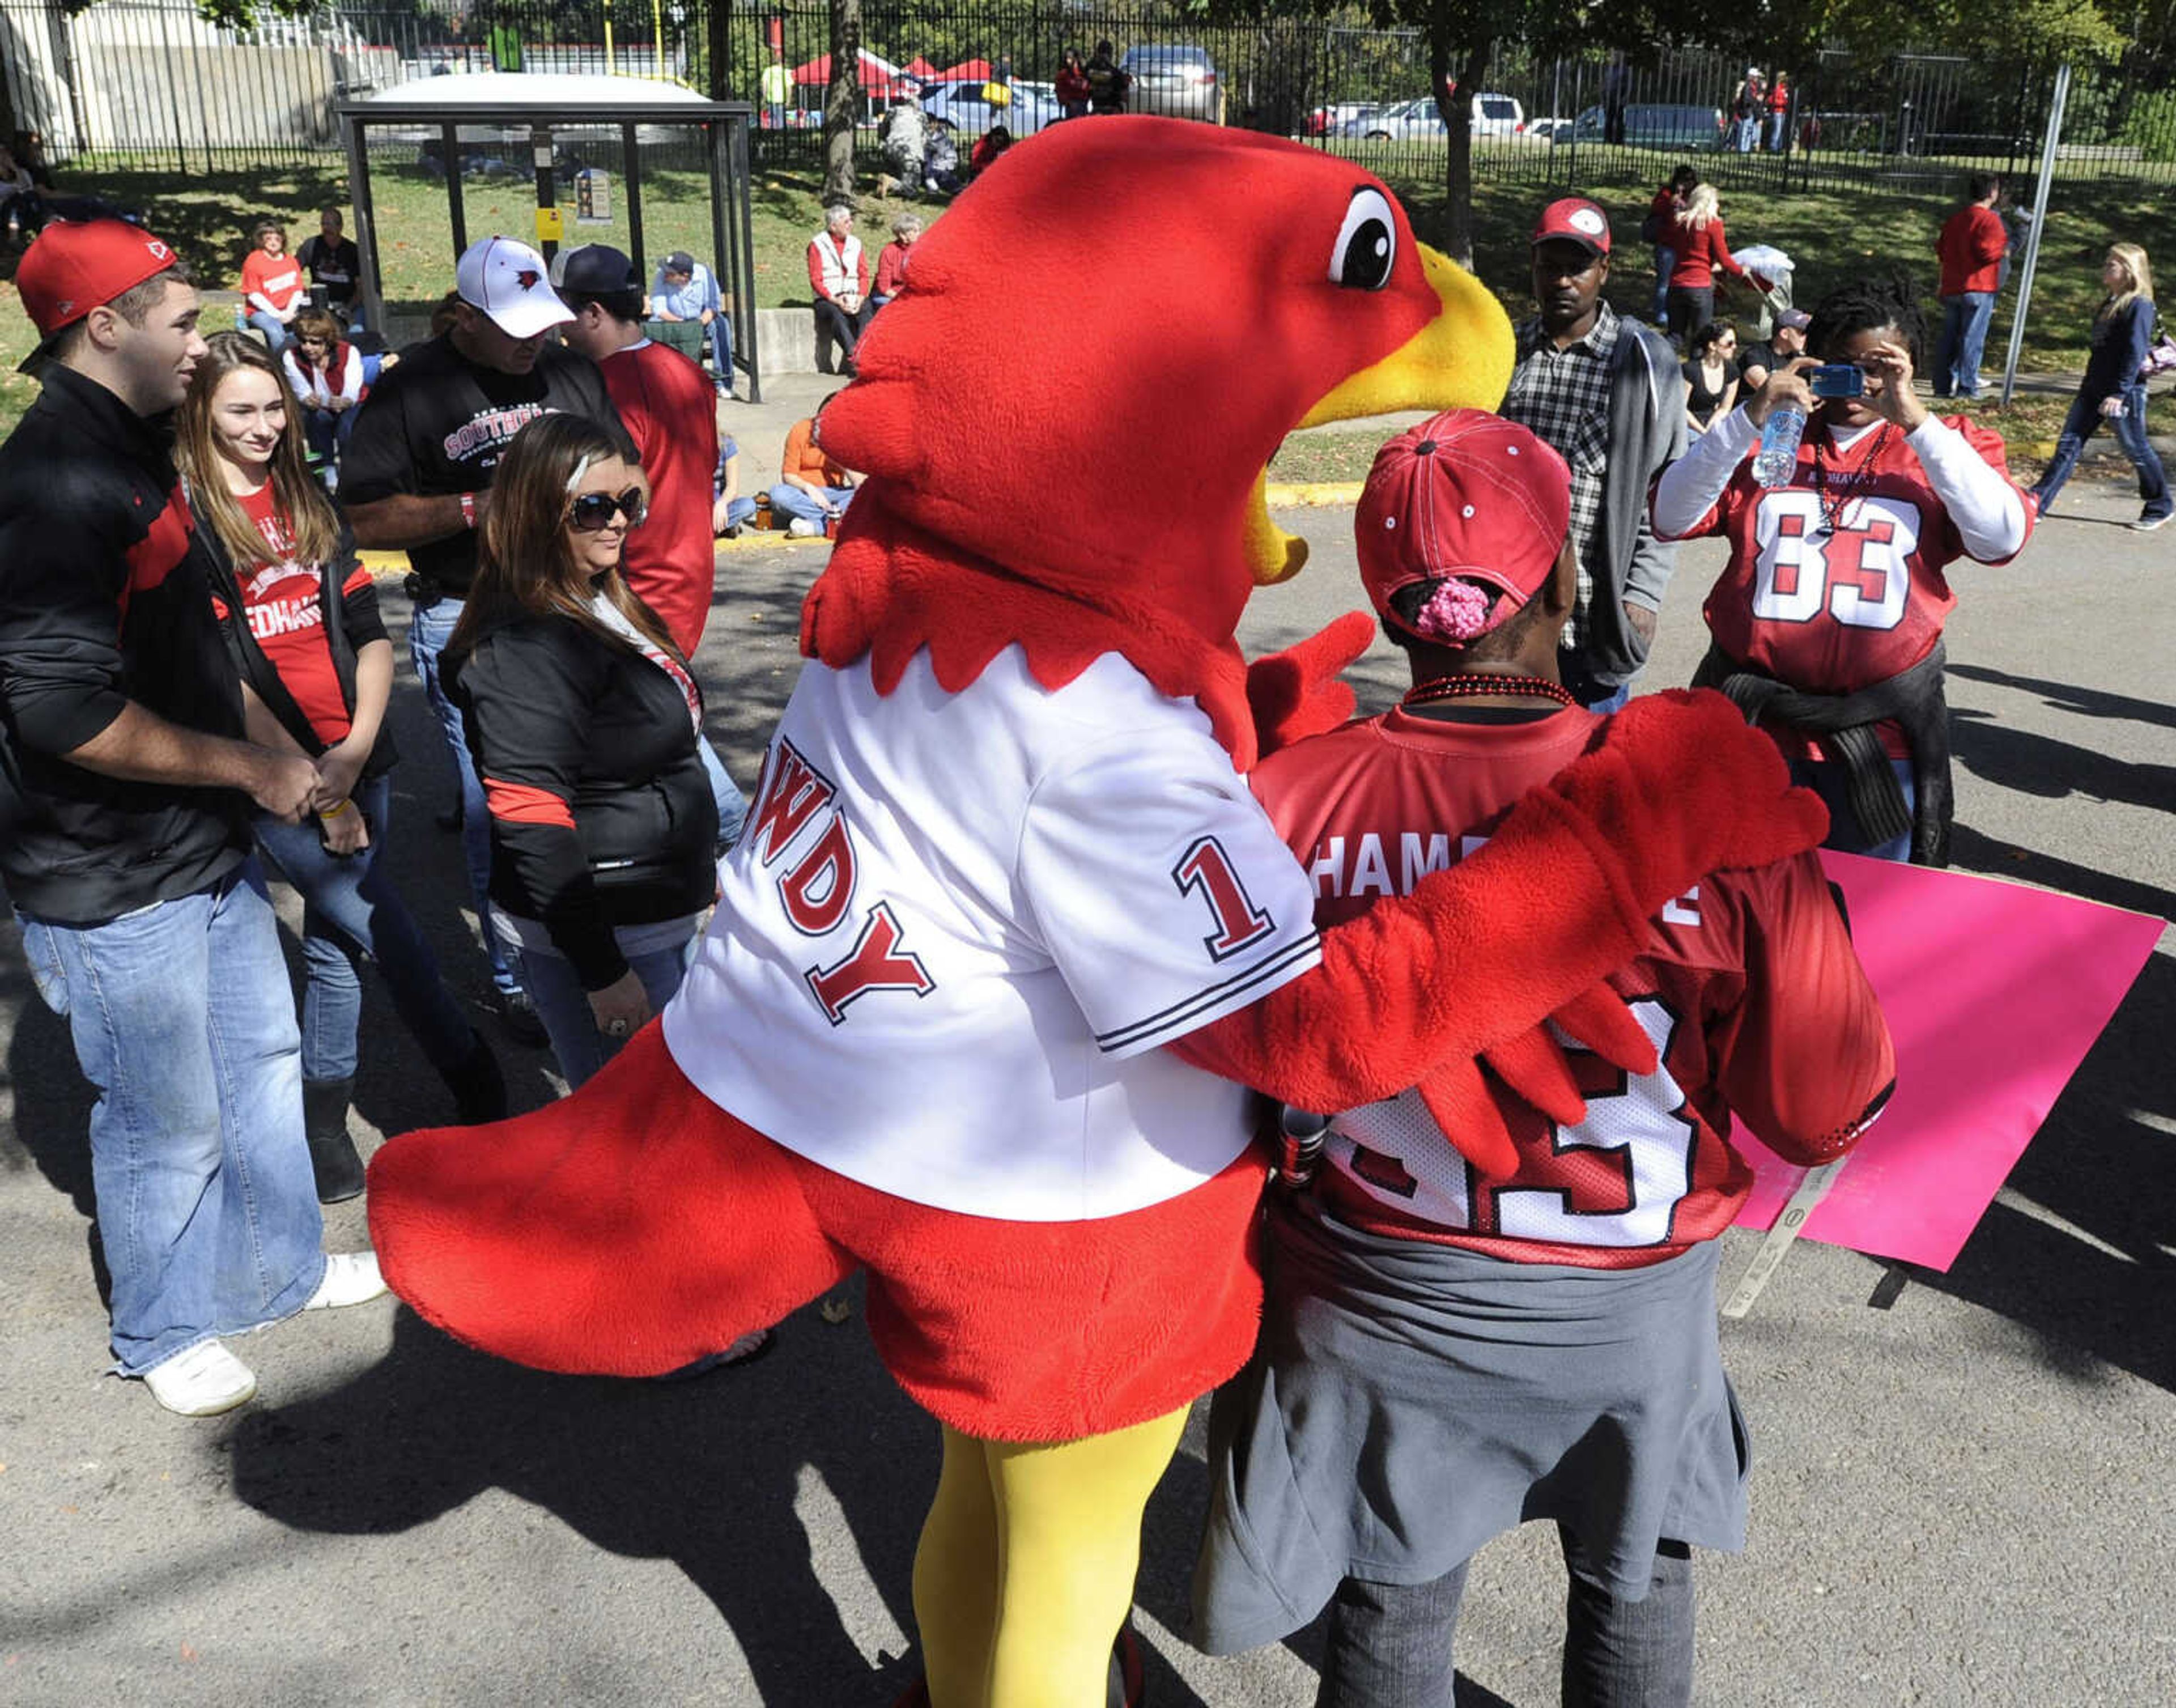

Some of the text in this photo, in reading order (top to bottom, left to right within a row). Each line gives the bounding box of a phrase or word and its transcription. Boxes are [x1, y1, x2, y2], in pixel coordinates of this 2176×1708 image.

[1752, 489, 1922, 631] 83
[738, 734, 937, 1026] WDY
[1171, 835, 1277, 964] 1
